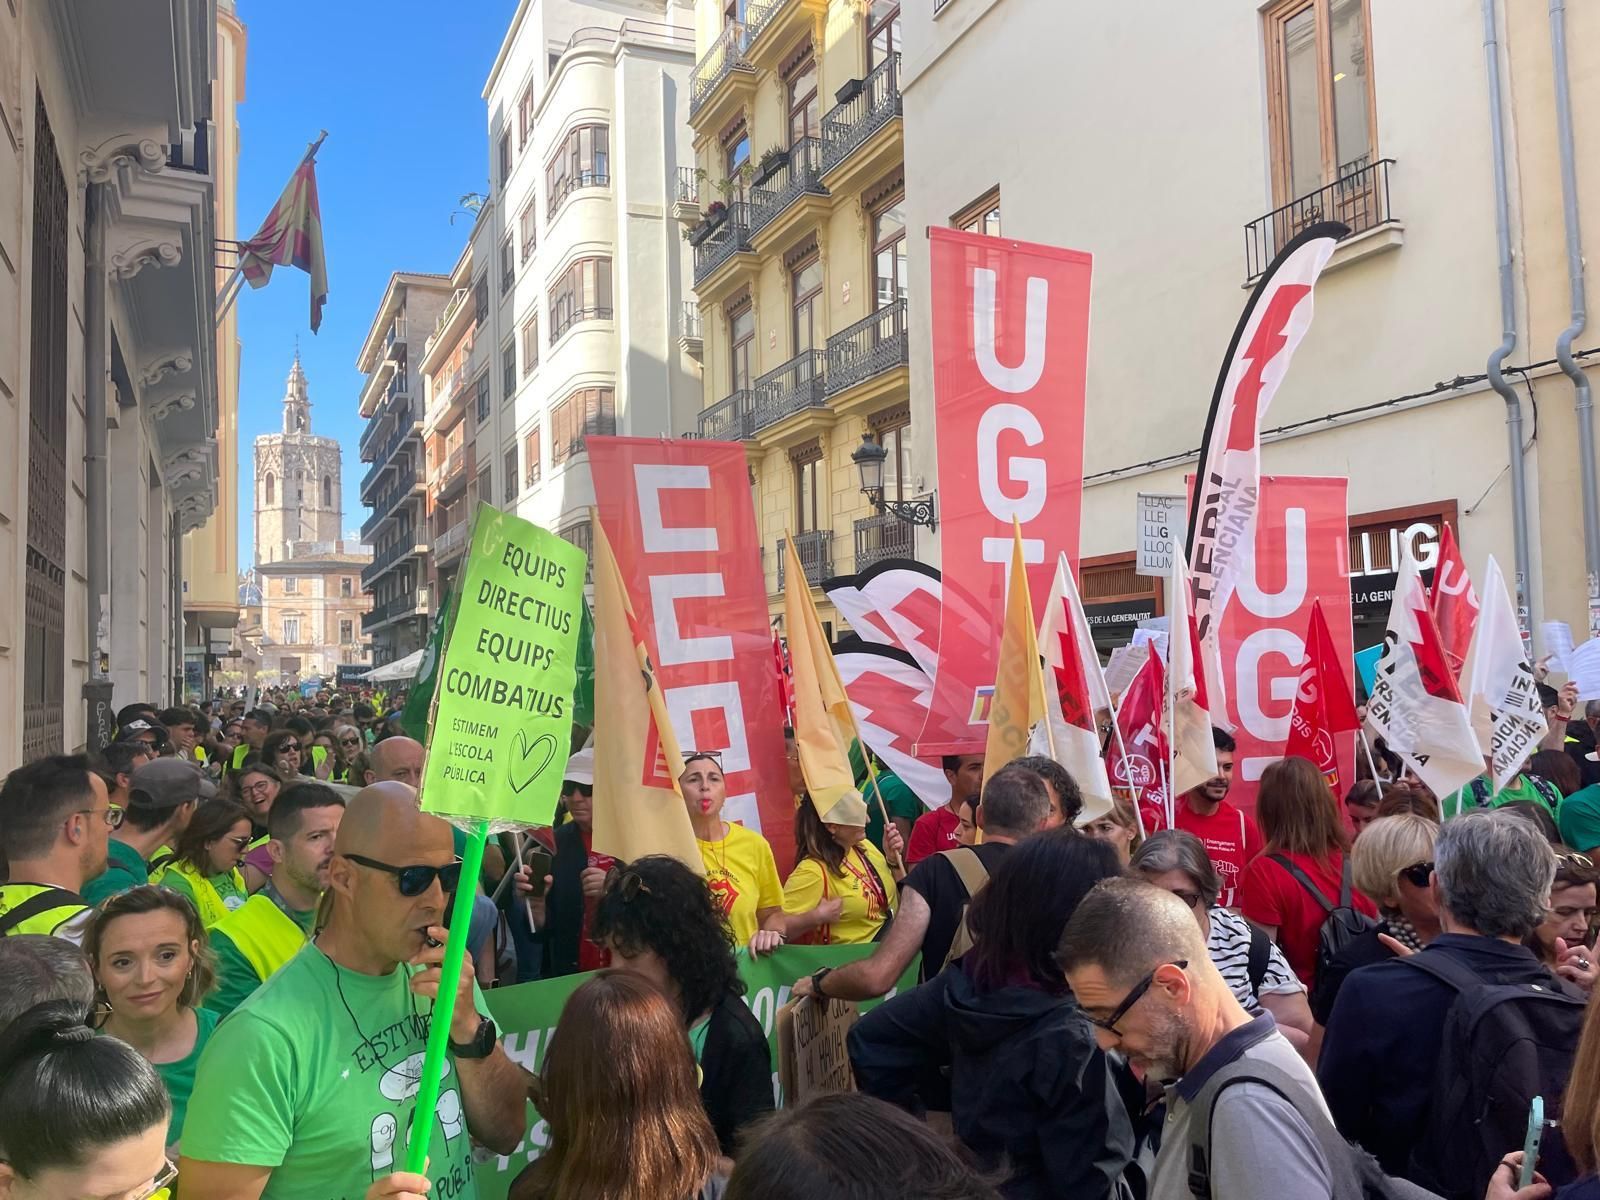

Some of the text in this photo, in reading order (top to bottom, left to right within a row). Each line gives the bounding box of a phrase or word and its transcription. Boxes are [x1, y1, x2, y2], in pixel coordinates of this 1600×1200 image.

[973, 267, 1049, 620] UGT
[1144, 511, 1167, 523] LLEI
[1144, 525, 1169, 538] LLIG
[1144, 540, 1173, 553] LLOC
[502, 542, 567, 588] EQUIPS
[477, 579, 571, 634] DIRECTIUS
[1356, 592, 1368, 604] LA
[1111, 612, 1151, 623] GENERALITAT
[476, 628, 555, 671] EQUIPS
[446, 668, 564, 719] COMBATIUS
[452, 718, 499, 739] ESTIMEM
[448, 741, 493, 762] L'ESCOLA
[443, 763, 486, 784] PÚBLICA
